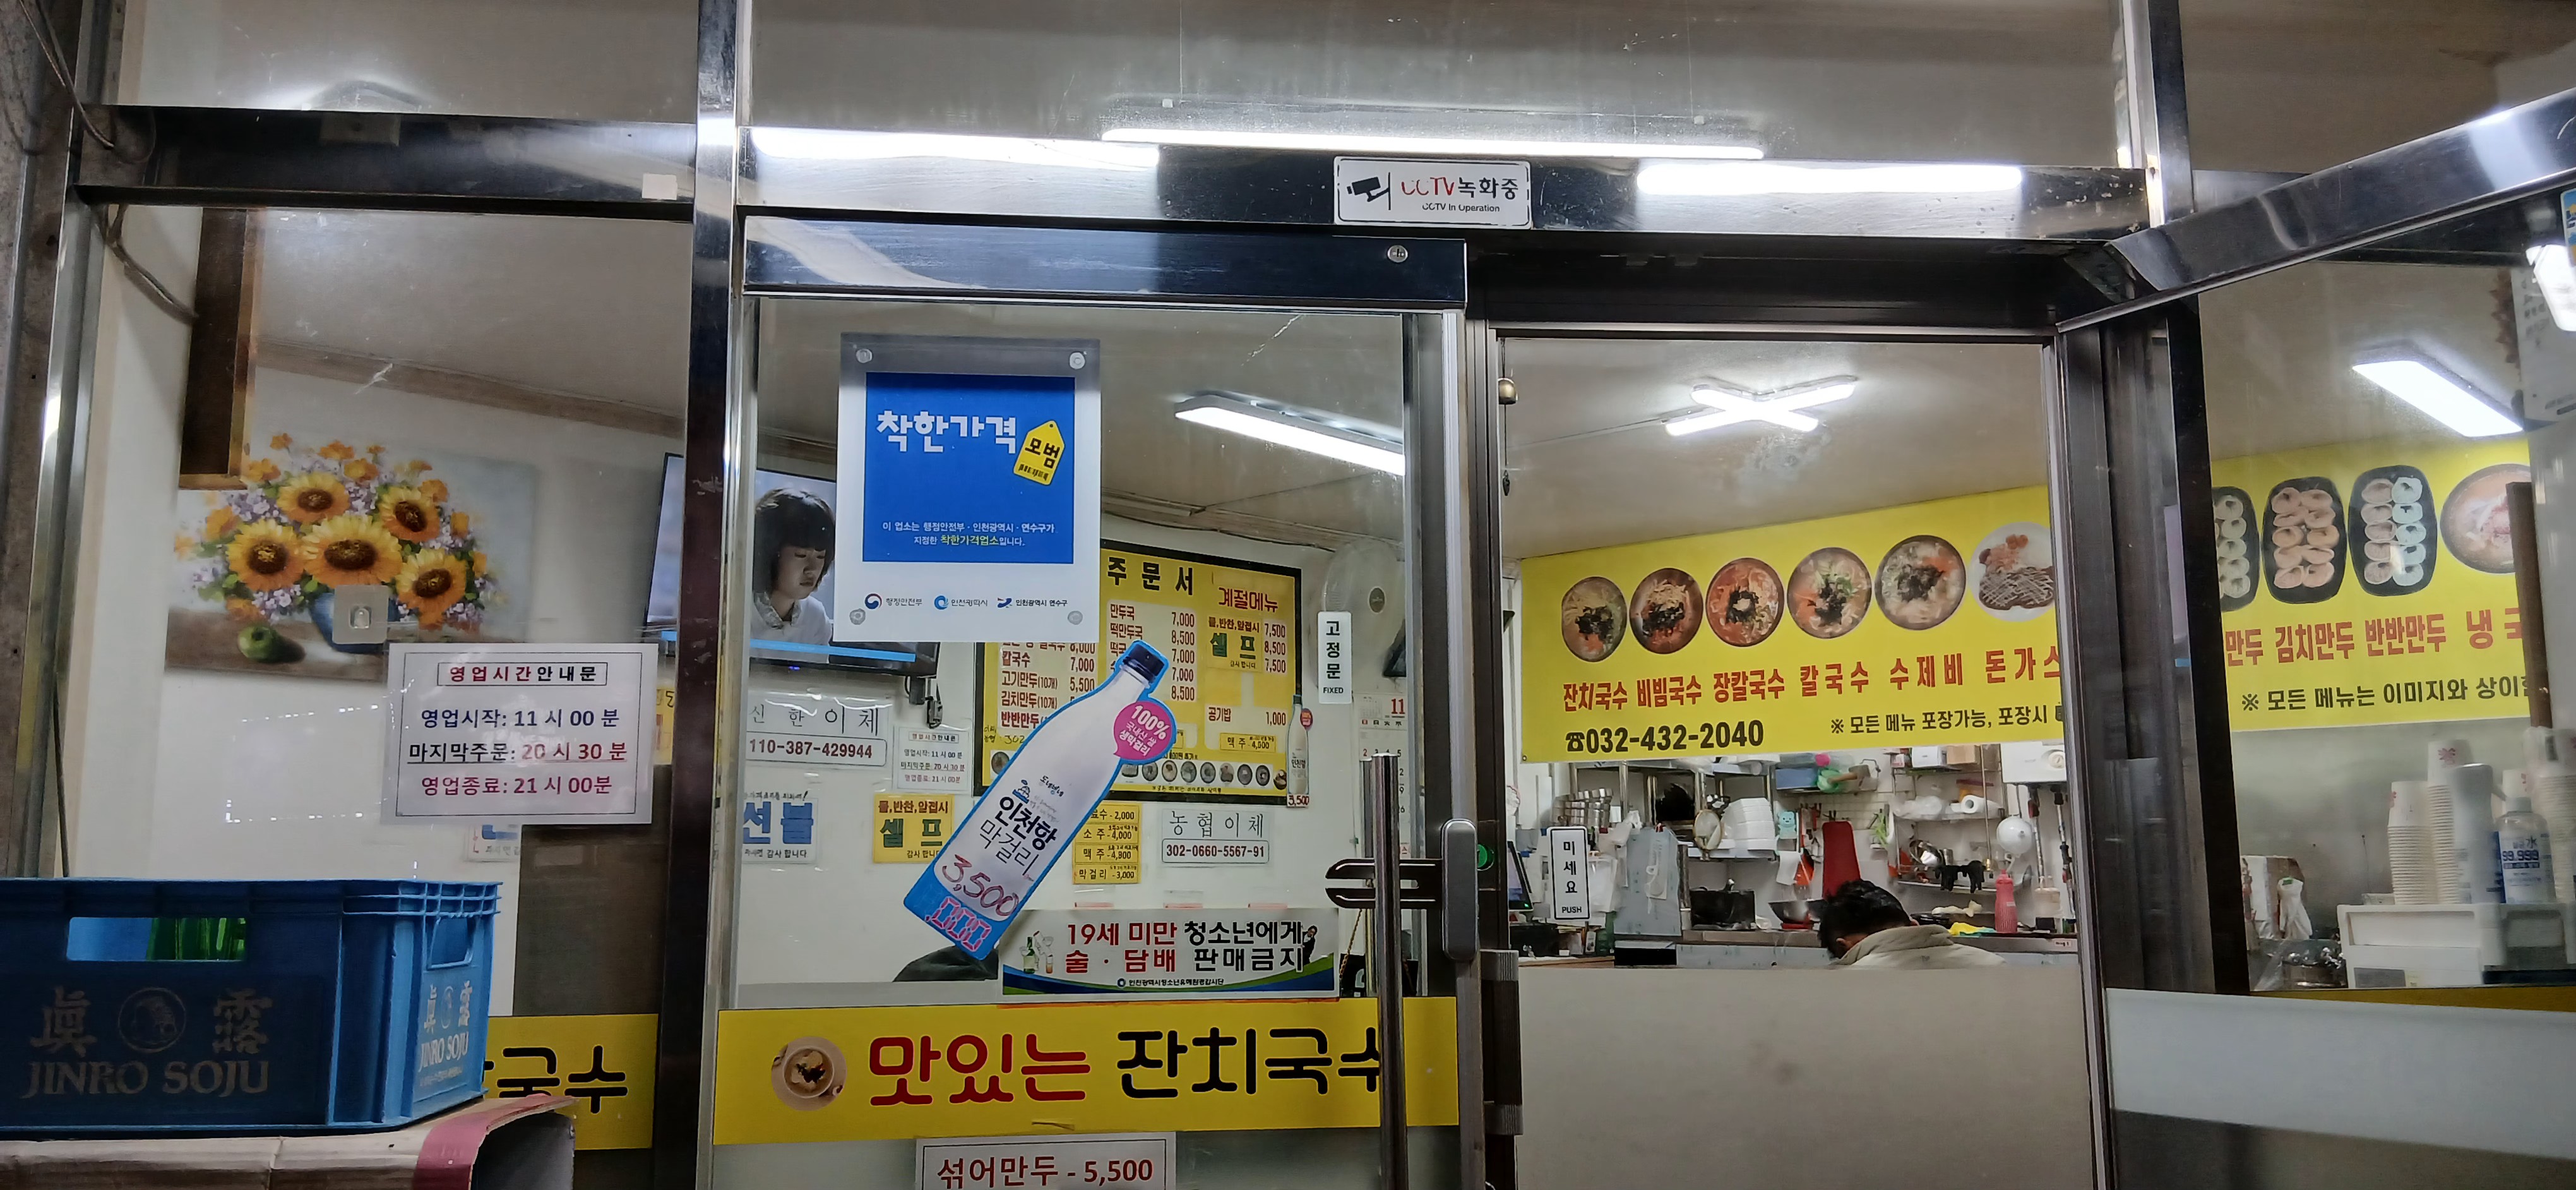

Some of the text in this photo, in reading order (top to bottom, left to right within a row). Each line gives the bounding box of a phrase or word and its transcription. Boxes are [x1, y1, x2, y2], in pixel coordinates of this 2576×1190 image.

[876, 409, 1016, 454] 착한가격
[1025, 437, 1061, 469] 모범
[882, 522, 891, 531] 이
[895, 522, 920, 532] 업소는
[973, 522, 1014, 533] 인천광역시
[1021, 523, 1055, 534] 연수구가
[914, 536, 938, 546] 지정한
[1218, 587, 1279, 613] 계절메뉴
[1110, 604, 1195, 628] 만두국 7,000
[1110, 622, 1195, 646] 떡만두국 8,500
[1264, 623, 1285, 638] 7,500
[2224, 628, 2264, 667] 만두
[2274, 621, 2356, 664] 김치만두
[2364, 613, 2447, 657] 반반만두
[1171, 649, 1195, 664] 7,000
[1210, 632, 1286, 660] 셀프 8,500
[1326, 620, 1341, 680] 고정문
[1002, 651, 1030, 668] 칼국수
[1070, 657, 1095, 672] 7,000
[1265, 658, 1286, 673] 7,500
[1001, 670, 1095, 692] 고기만두(10개) 5,500
[1171, 667, 1195, 683] 7,000
[1563, 646, 2061, 712] 잔치국수 비빔국수 장칼국수 칼국수 수제비 돈가스
[1001, 691, 1058, 709] 김치만두(10개)
[1171, 685, 1195, 702] 8,500
[2267, 688, 2307, 711] 모든
[2315, 685, 2376, 709] 메뉴는
[2383, 678, 2469, 705] 이미지와
[1208, 706, 1232, 723] 공기밥
[1265, 712, 1287, 726] 1,000
[1391, 698, 1405, 714] 11
[421, 709, 620, 729] 영업시작: 11 시 00 분
[1001, 711, 1047, 729] 반반만두(
[1131, 705, 1170, 740] 100%
[1850, 714, 1879, 736] 모든
[1885, 712, 1917, 734] 메뉴
[1921, 708, 1992, 733] 포장가능,
[1998, 704, 2048, 726] 포장시
[1119, 730, 1151, 757] 생막걸리
[1126, 721, 1148, 742] 국내산
[408, 742, 628, 762] 마지막주문: 20 시 30 분
[749, 738, 873, 759] 110-387-429944
[421, 776, 508, 796] 영업종료:
[513, 778, 537, 794] 21
[544, 776, 561, 795] 시
[994, 796, 1058, 851] 인천항
[1114, 811, 1135, 821] 2,000
[880, 818, 943, 848] 셀프
[767, 849, 808, 858] 감사 합니다
[907, 850, 920, 858] 감사
[979, 819, 1041, 877] 막걸리
[1166, 844, 1265, 858] 302-0660-5567-91
[1563, 841, 1578, 894] 미세요
[942, 854, 1020, 917] 3,500
[1561, 906, 1582, 914] PUSH
[1068, 921, 1303, 946] 19세 미만 청소년에게
[1065, 947, 1304, 974] 술 담배 판매금지
[418, 1031, 469, 1073] JINRO SOJU
[21, 1060, 270, 1098] JINRO SOJU
[484, 1045, 628, 1114] 국수
[868, 1032, 1091, 1106] 맛있는
[938, 1155, 1059, 1189] 섞어만두
[1083, 1158, 1154, 1187] 5,500
